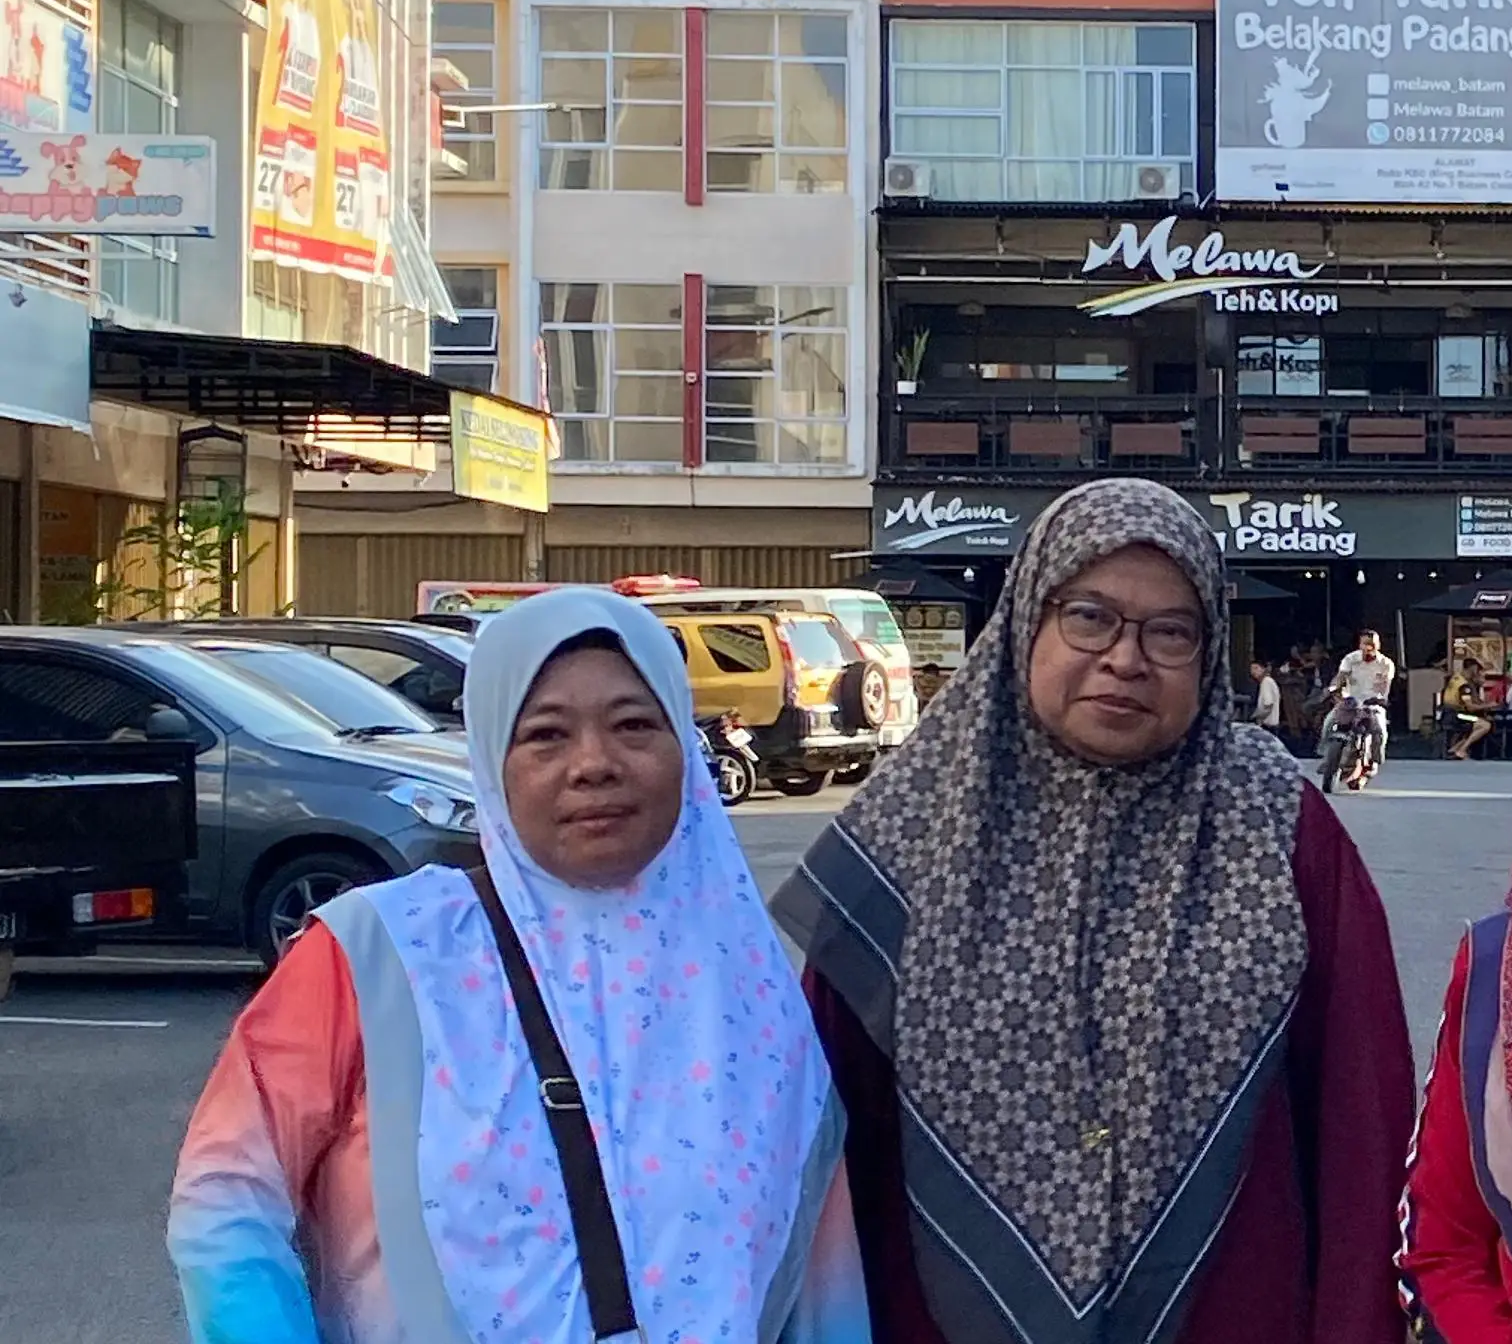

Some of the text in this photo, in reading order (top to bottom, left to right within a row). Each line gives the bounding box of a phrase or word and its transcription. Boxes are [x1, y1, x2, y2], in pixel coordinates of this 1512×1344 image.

[1235, 11, 1392, 58] Belakang
[1393, 76, 1506, 94] melawa_batam
[1393, 102, 1505, 118] Melawa Batam
[1081, 215, 1326, 282] Melawa
[884, 490, 1021, 529] Melawa
[1209, 492, 1343, 529] Tarik
[1235, 527, 1356, 556] Padang
